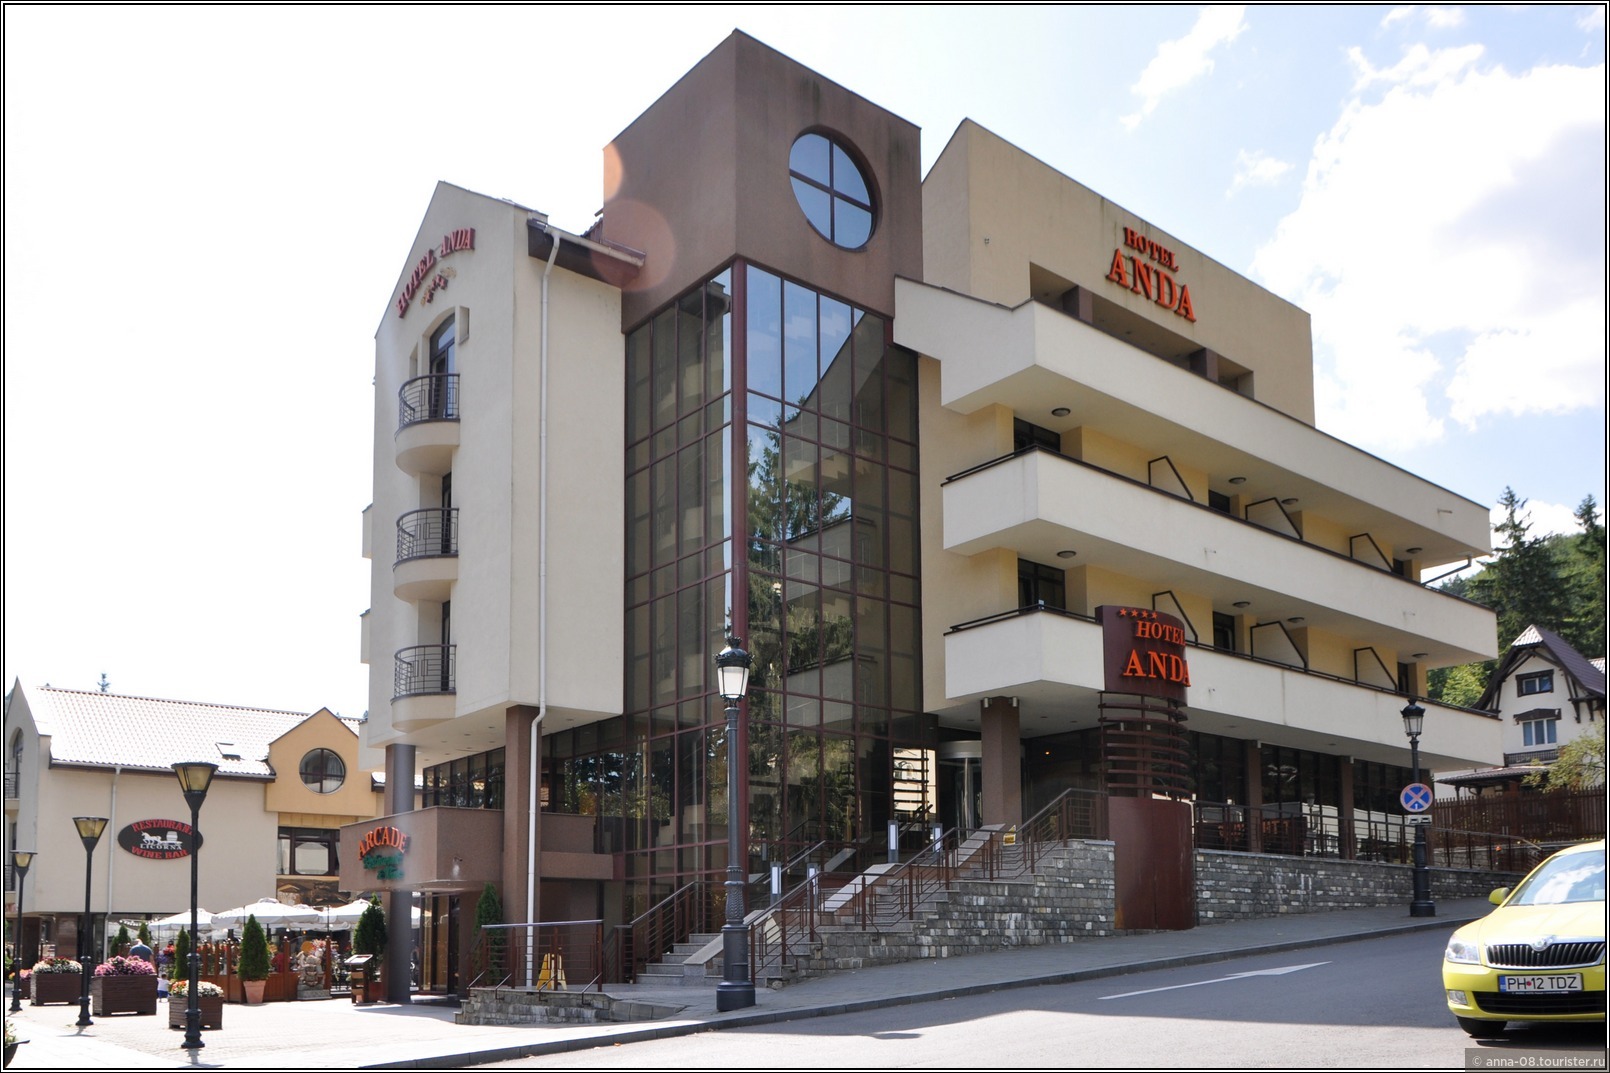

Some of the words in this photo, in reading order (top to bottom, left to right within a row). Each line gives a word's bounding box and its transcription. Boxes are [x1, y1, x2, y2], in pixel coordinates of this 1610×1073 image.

[1123, 226, 1179, 272] HOTEL
[396, 248, 437, 319] HOTEL
[440, 227, 476, 258] ANDA
[1105, 248, 1197, 323] ANDA
[1136, 620, 1186, 646] HOTEL
[1123, 648, 1191, 687] ANDA
[131, 846, 162, 859] WINE
[165, 849, 188, 859] BAR
[358, 826, 408, 861] ARCADE
[1507, 977, 1527, 990] PH
[1530, 977, 1545, 990] 12
[1547, 976, 1578, 989] TDZ
